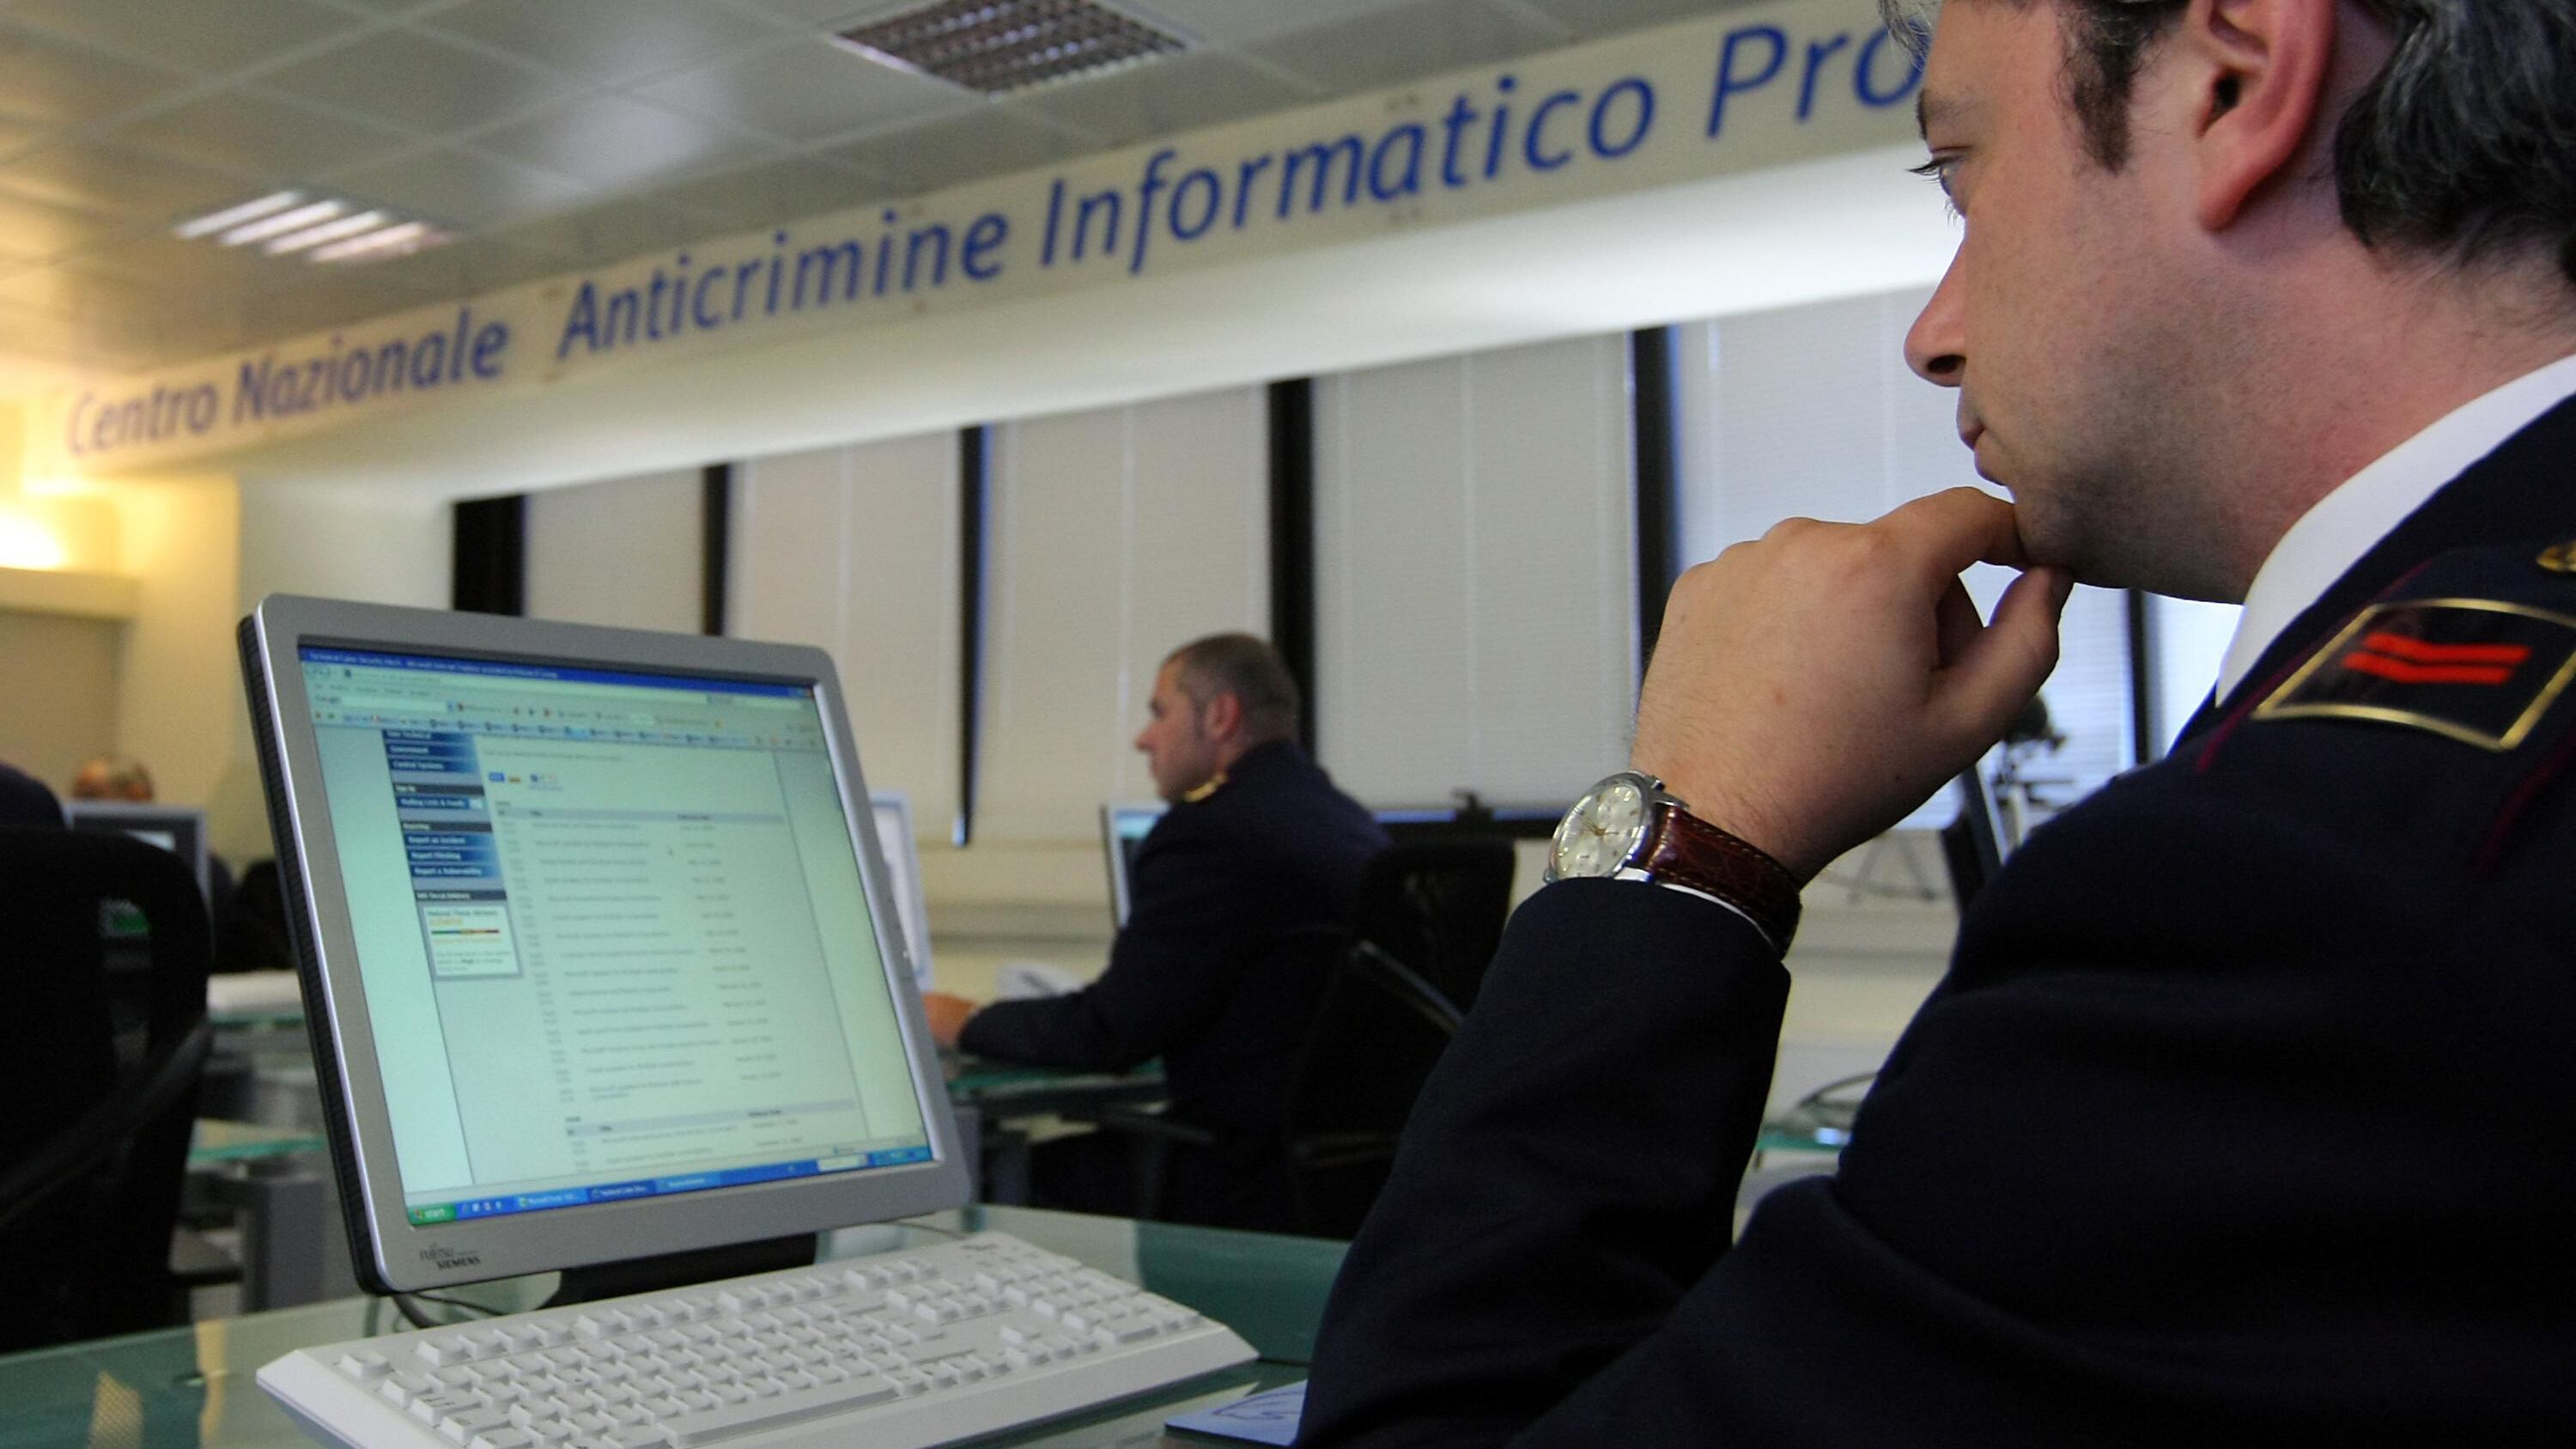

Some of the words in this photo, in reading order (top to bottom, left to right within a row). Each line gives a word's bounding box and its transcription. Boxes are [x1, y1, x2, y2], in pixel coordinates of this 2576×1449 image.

[67, 383, 219, 458] Centro
[232, 307, 510, 424] Nazionale
[556, 210, 1010, 360] Anticrimine
[1041, 74, 1657, 275] Informatico
[1706, 19, 1931, 139] Pro
